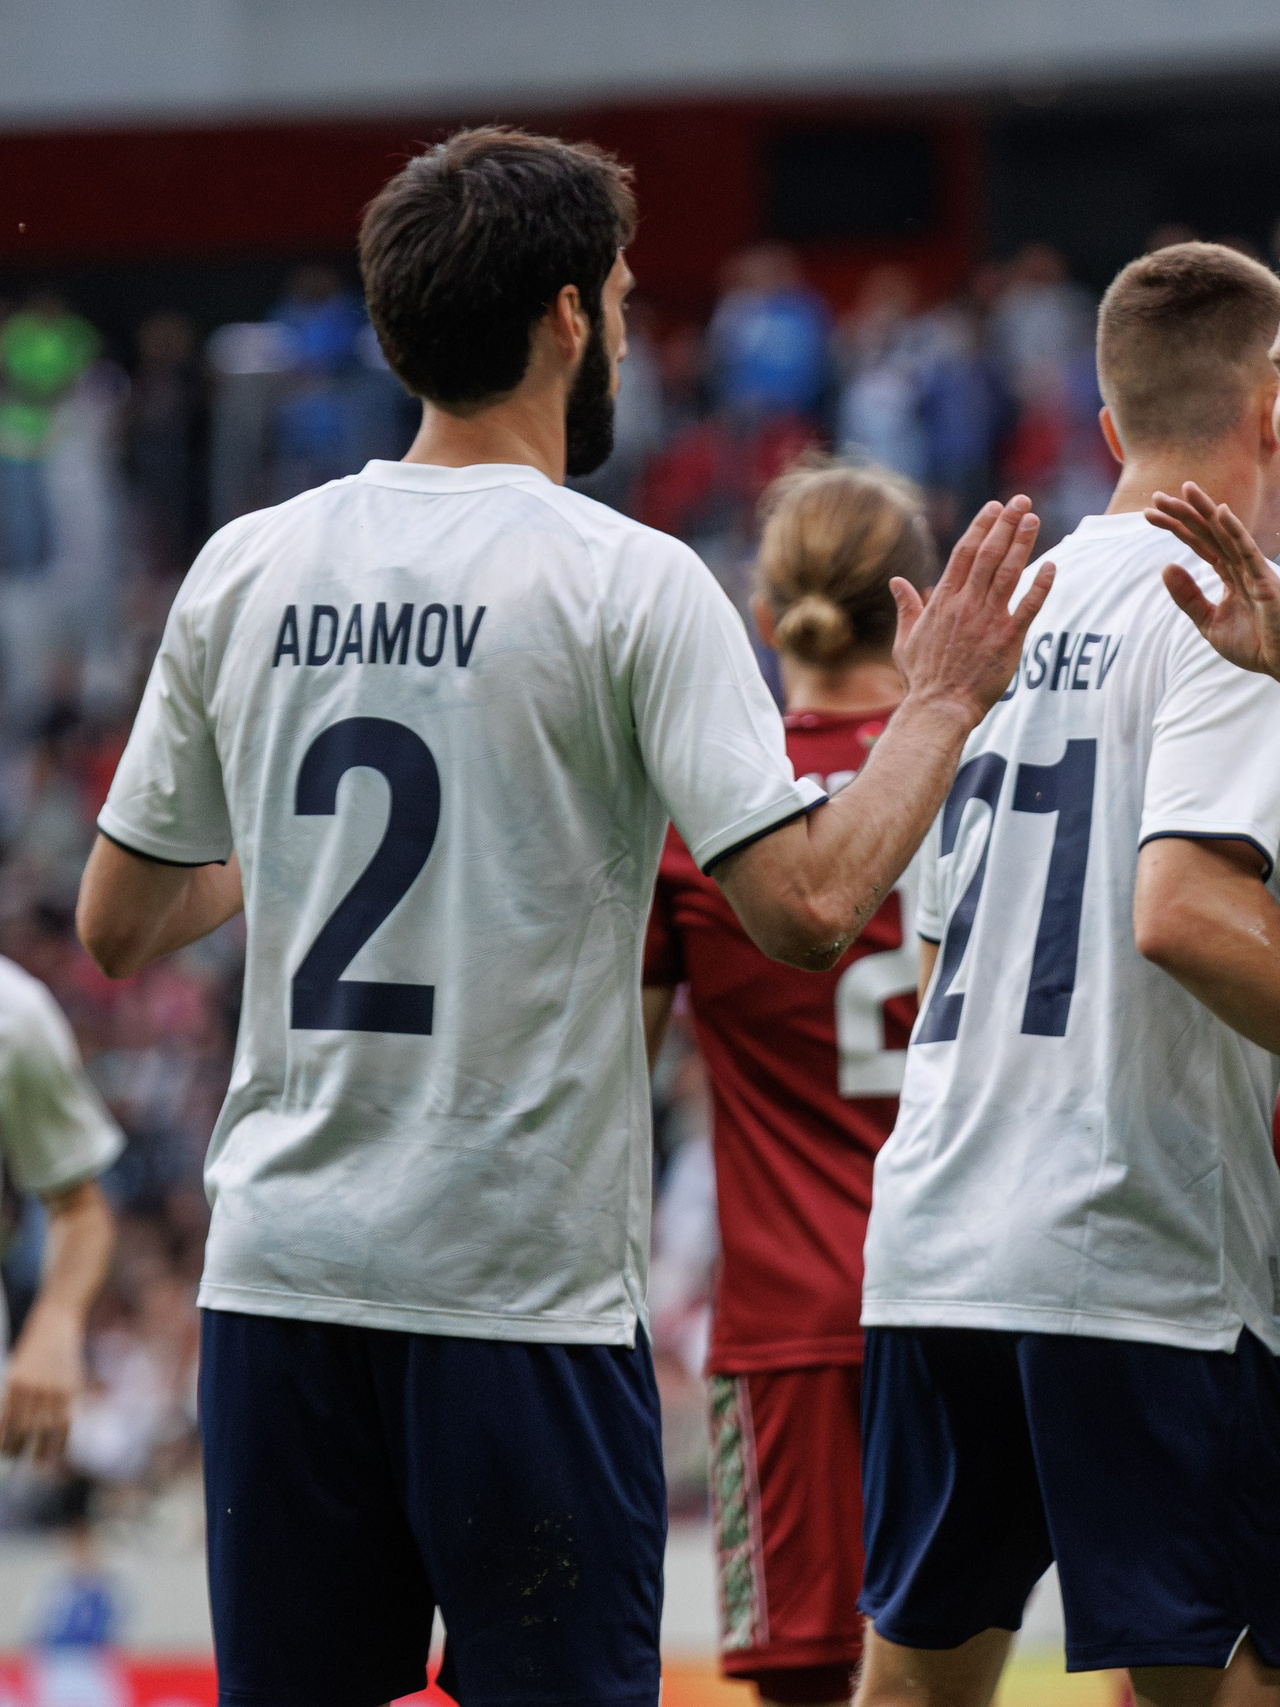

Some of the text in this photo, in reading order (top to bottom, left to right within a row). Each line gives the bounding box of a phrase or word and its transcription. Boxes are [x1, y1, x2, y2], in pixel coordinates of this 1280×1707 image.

[271, 602, 487, 668] ADAMOV
[289, 716, 441, 1036] 2
[914, 736, 1098, 1046] 21
